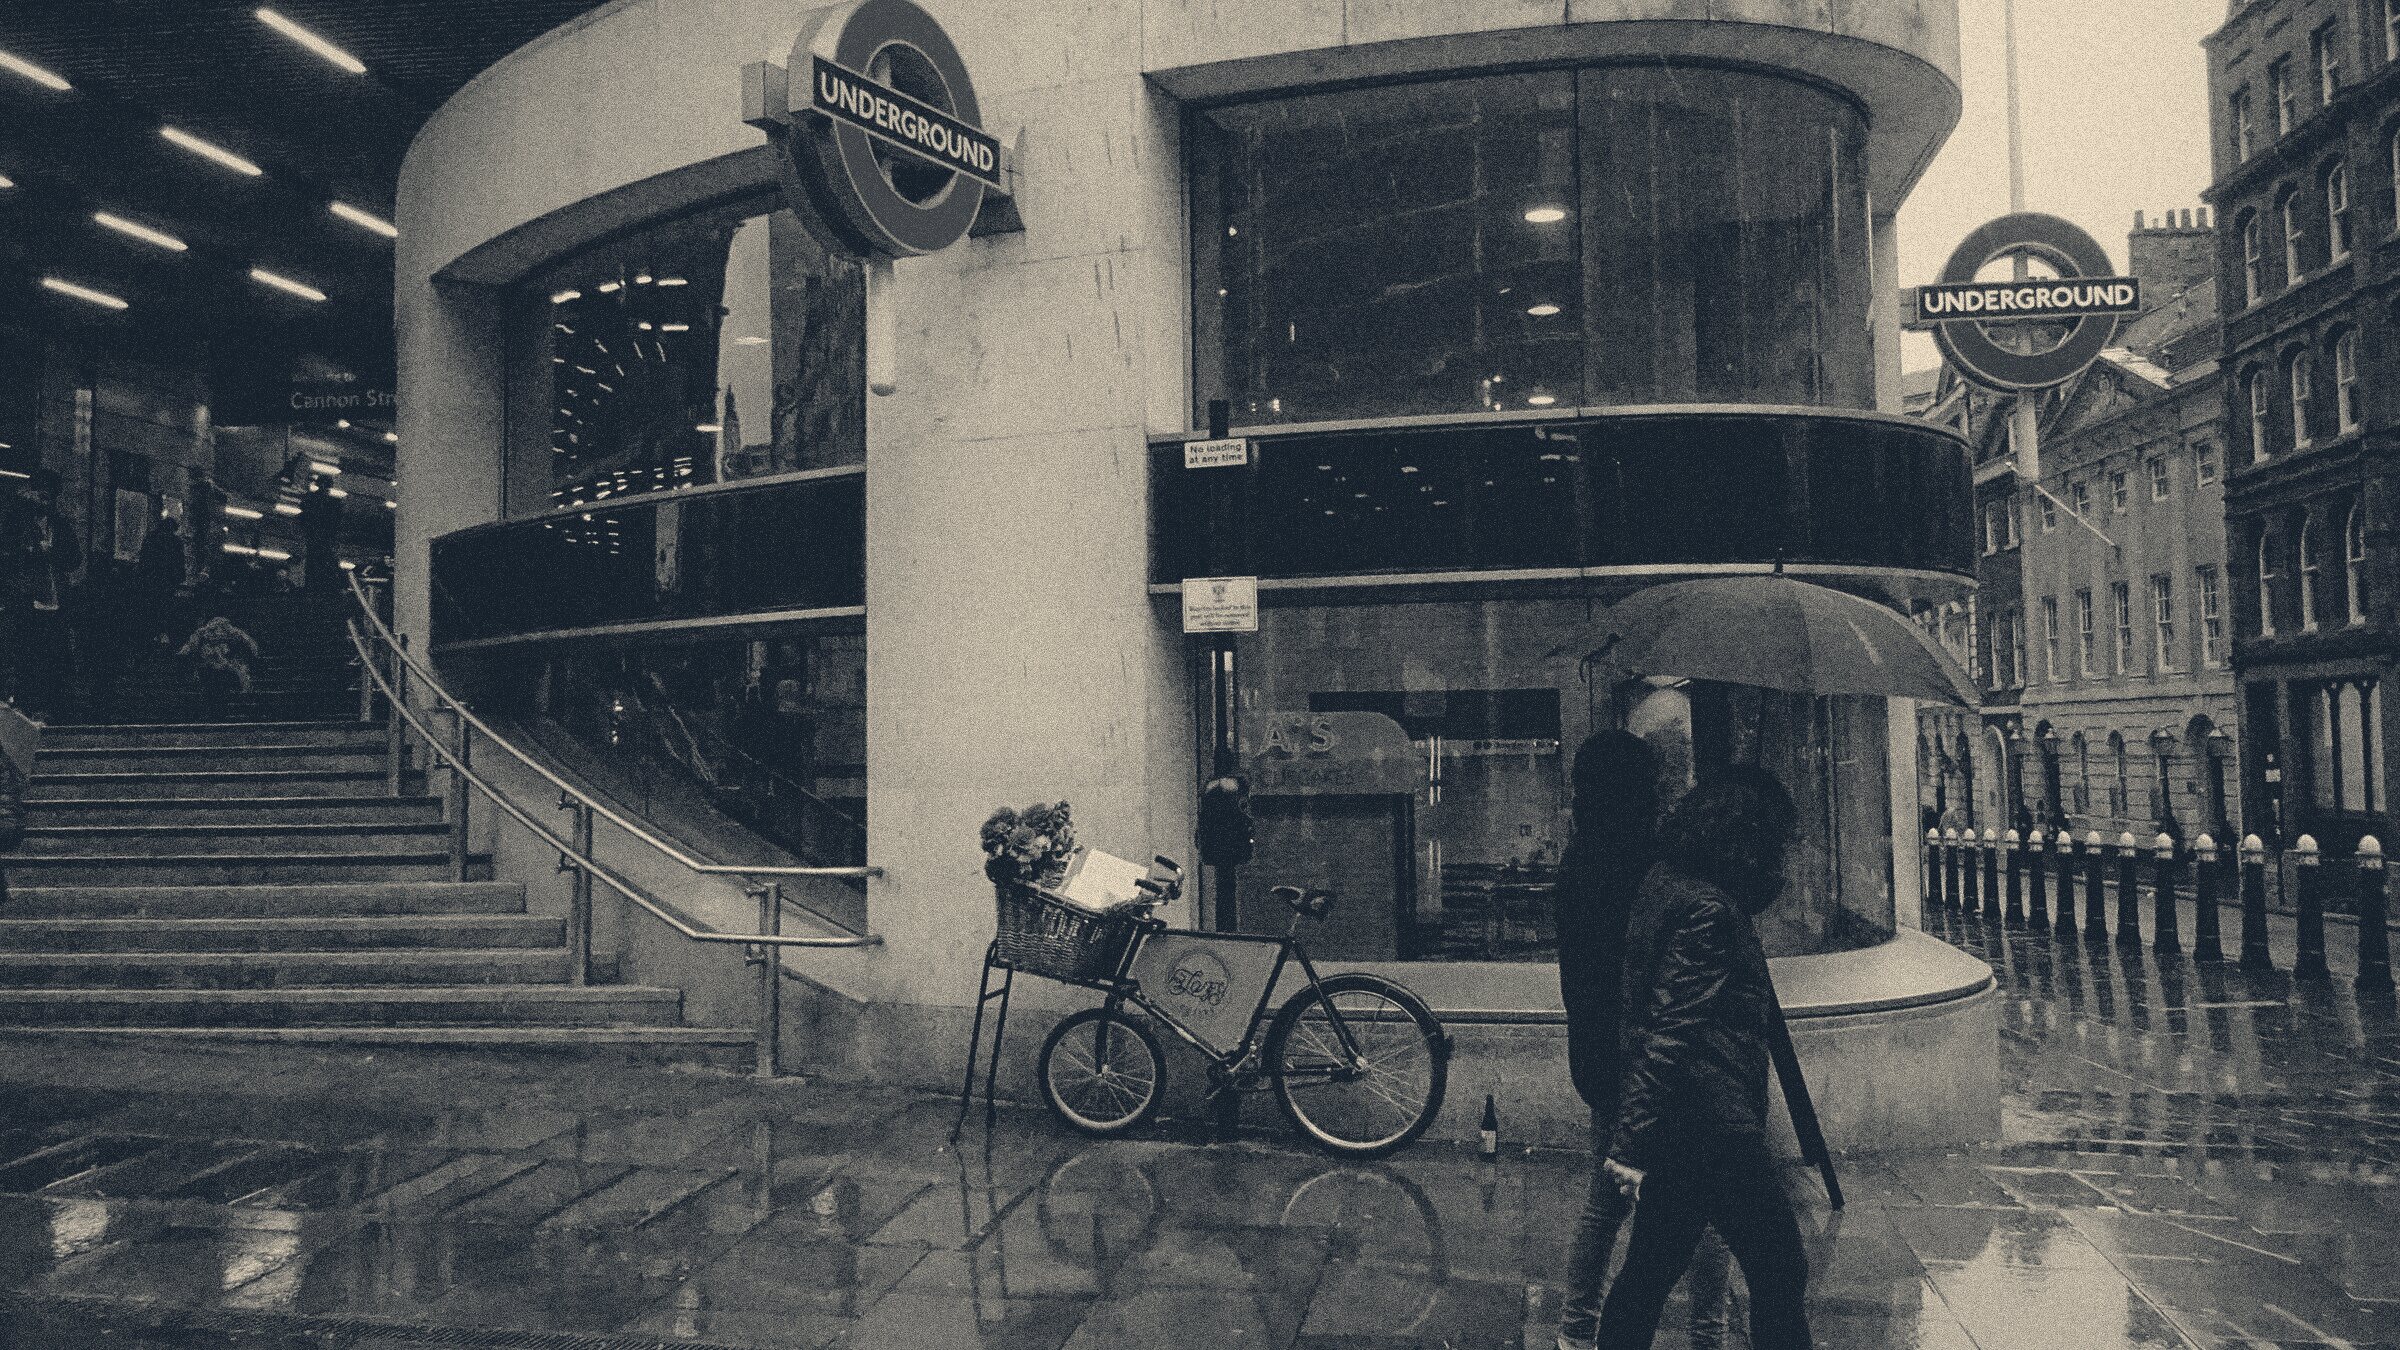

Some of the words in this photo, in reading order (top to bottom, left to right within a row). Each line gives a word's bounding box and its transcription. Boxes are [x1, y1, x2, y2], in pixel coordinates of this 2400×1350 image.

[820, 71, 994, 172] UNDERGROUND
[1924, 284, 2134, 313] UNDERGROUND
[290, 391, 360, 409] Cannon
[1207, 443, 1242, 453] loading
[1189, 456, 1198, 464] at
[1202, 456, 1219, 464] any
[1221, 453, 1243, 462] time
